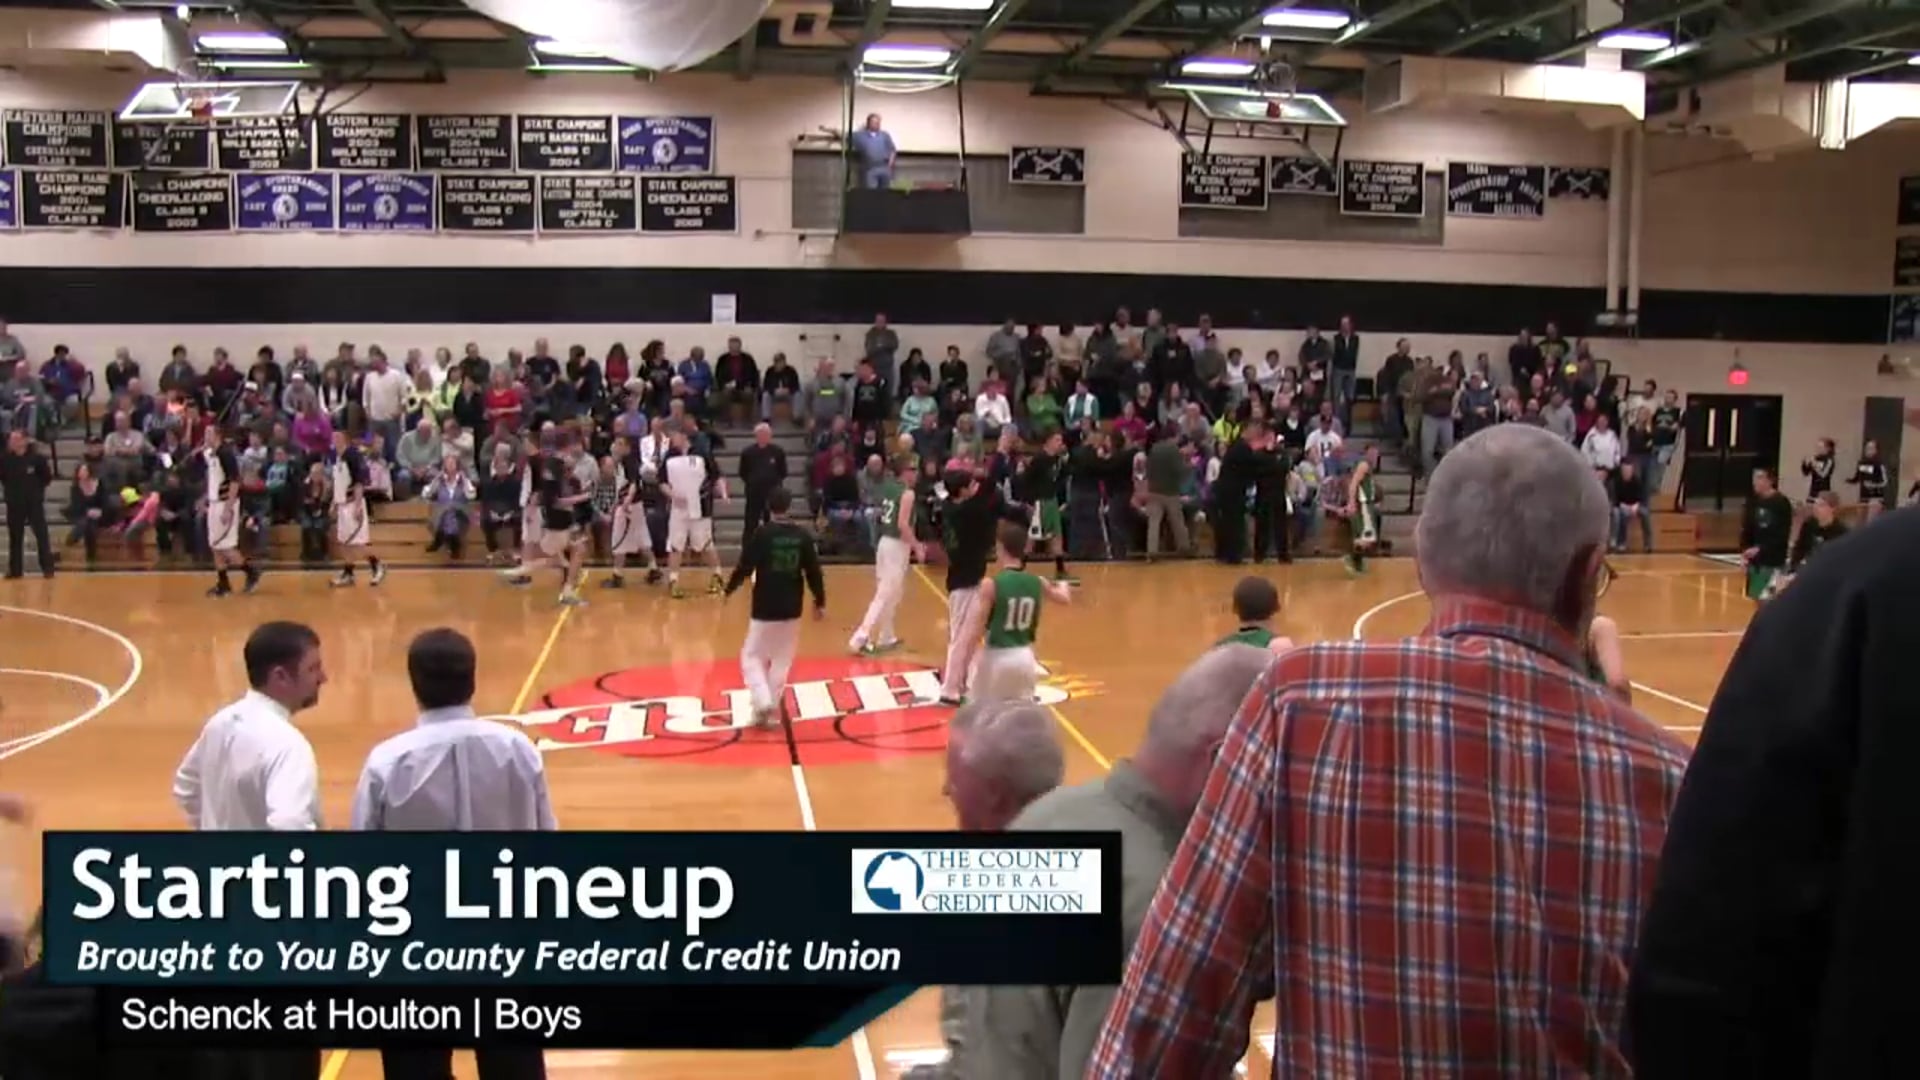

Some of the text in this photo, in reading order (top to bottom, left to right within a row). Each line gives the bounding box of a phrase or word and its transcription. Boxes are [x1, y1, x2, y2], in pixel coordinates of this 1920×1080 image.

[524, 119, 606, 129] STATE CHAMPIONS
[332, 128, 395, 137] CHAMPIONS
[432, 128, 497, 137] CHAMPIONS
[548, 132, 608, 142] BASKETBALL
[540, 145, 578, 154] CLASS
[39, 184, 107, 195] CHAMPIONS
[447, 180, 475, 189] STATE
[648, 180, 678, 191] STATE
[138, 192, 225, 204] CHEERLEADING
[445, 192, 532, 203] CHEERLEADING
[647, 193, 728, 204] CHEERLEADING
[155, 206, 195, 216] CLASS
[462, 205, 501, 215] CLASS
[663, 206, 701, 215] CLASS
[1004, 597, 1034, 631] 10
